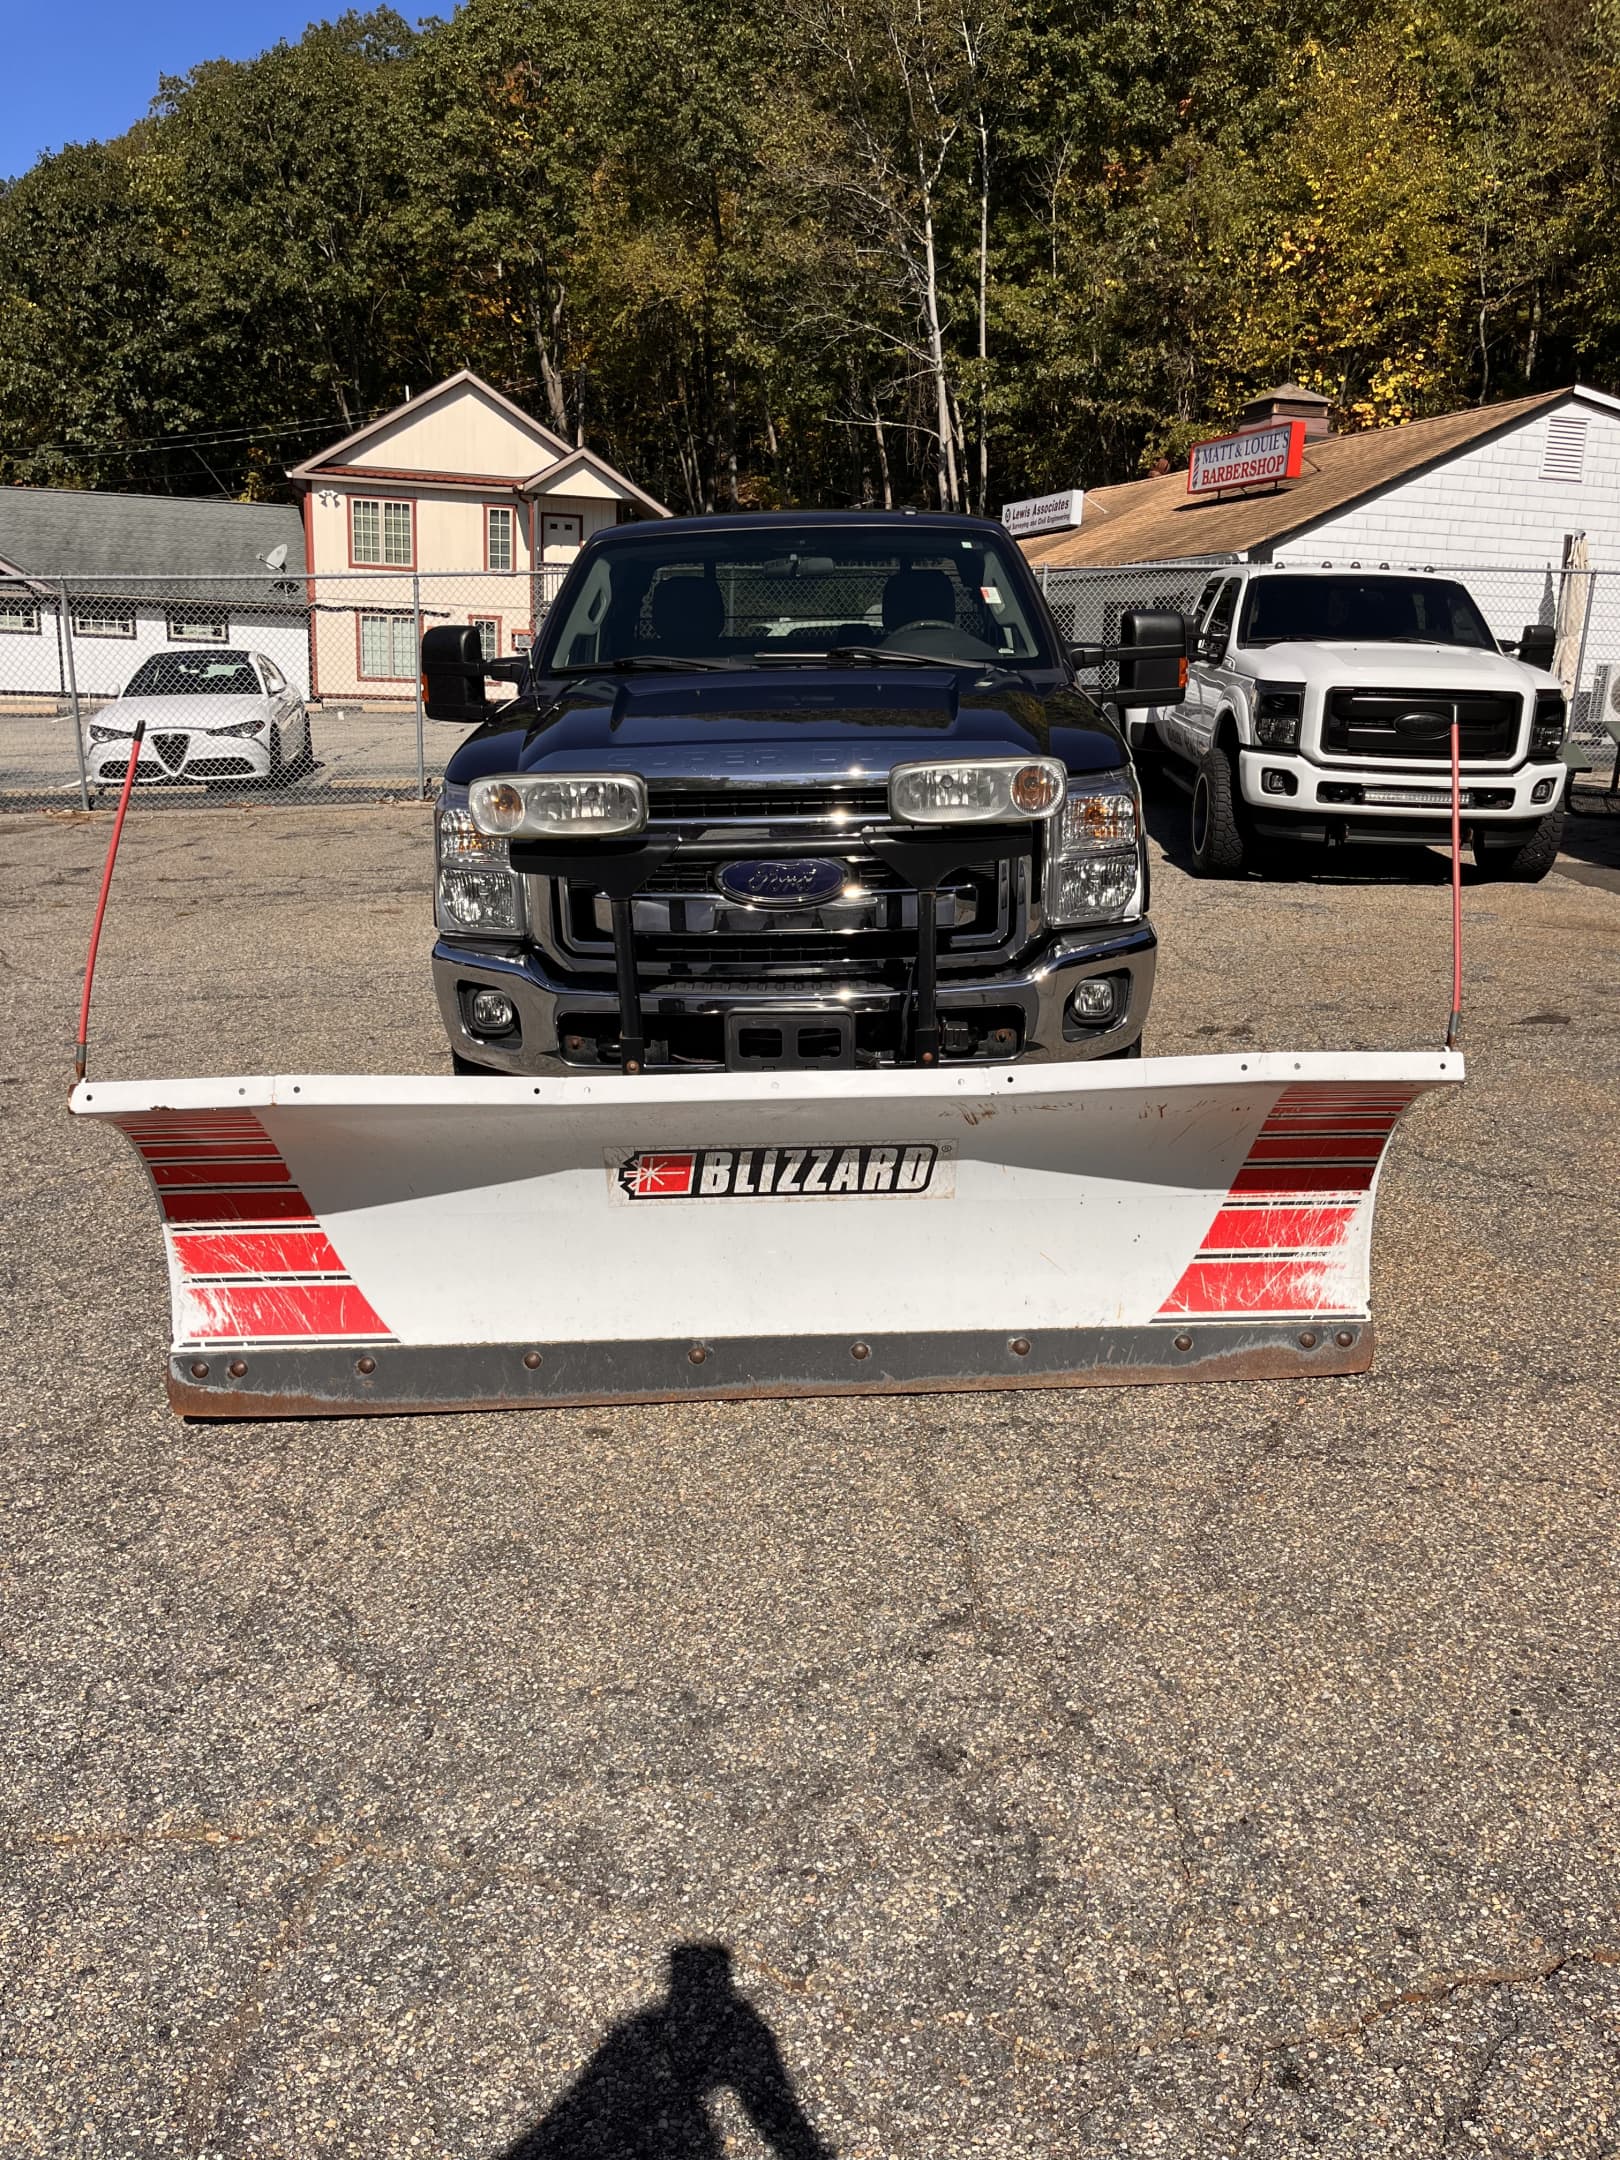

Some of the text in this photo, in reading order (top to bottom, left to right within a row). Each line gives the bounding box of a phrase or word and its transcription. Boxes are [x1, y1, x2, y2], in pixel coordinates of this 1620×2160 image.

[1202, 430, 1289, 465] MATT & LOUIE'S
[1201, 454, 1285, 486] BARBERSHOP
[1012, 499, 1070, 520] Lewis Associates
[700, 1147, 934, 1194] BLIZZARD
